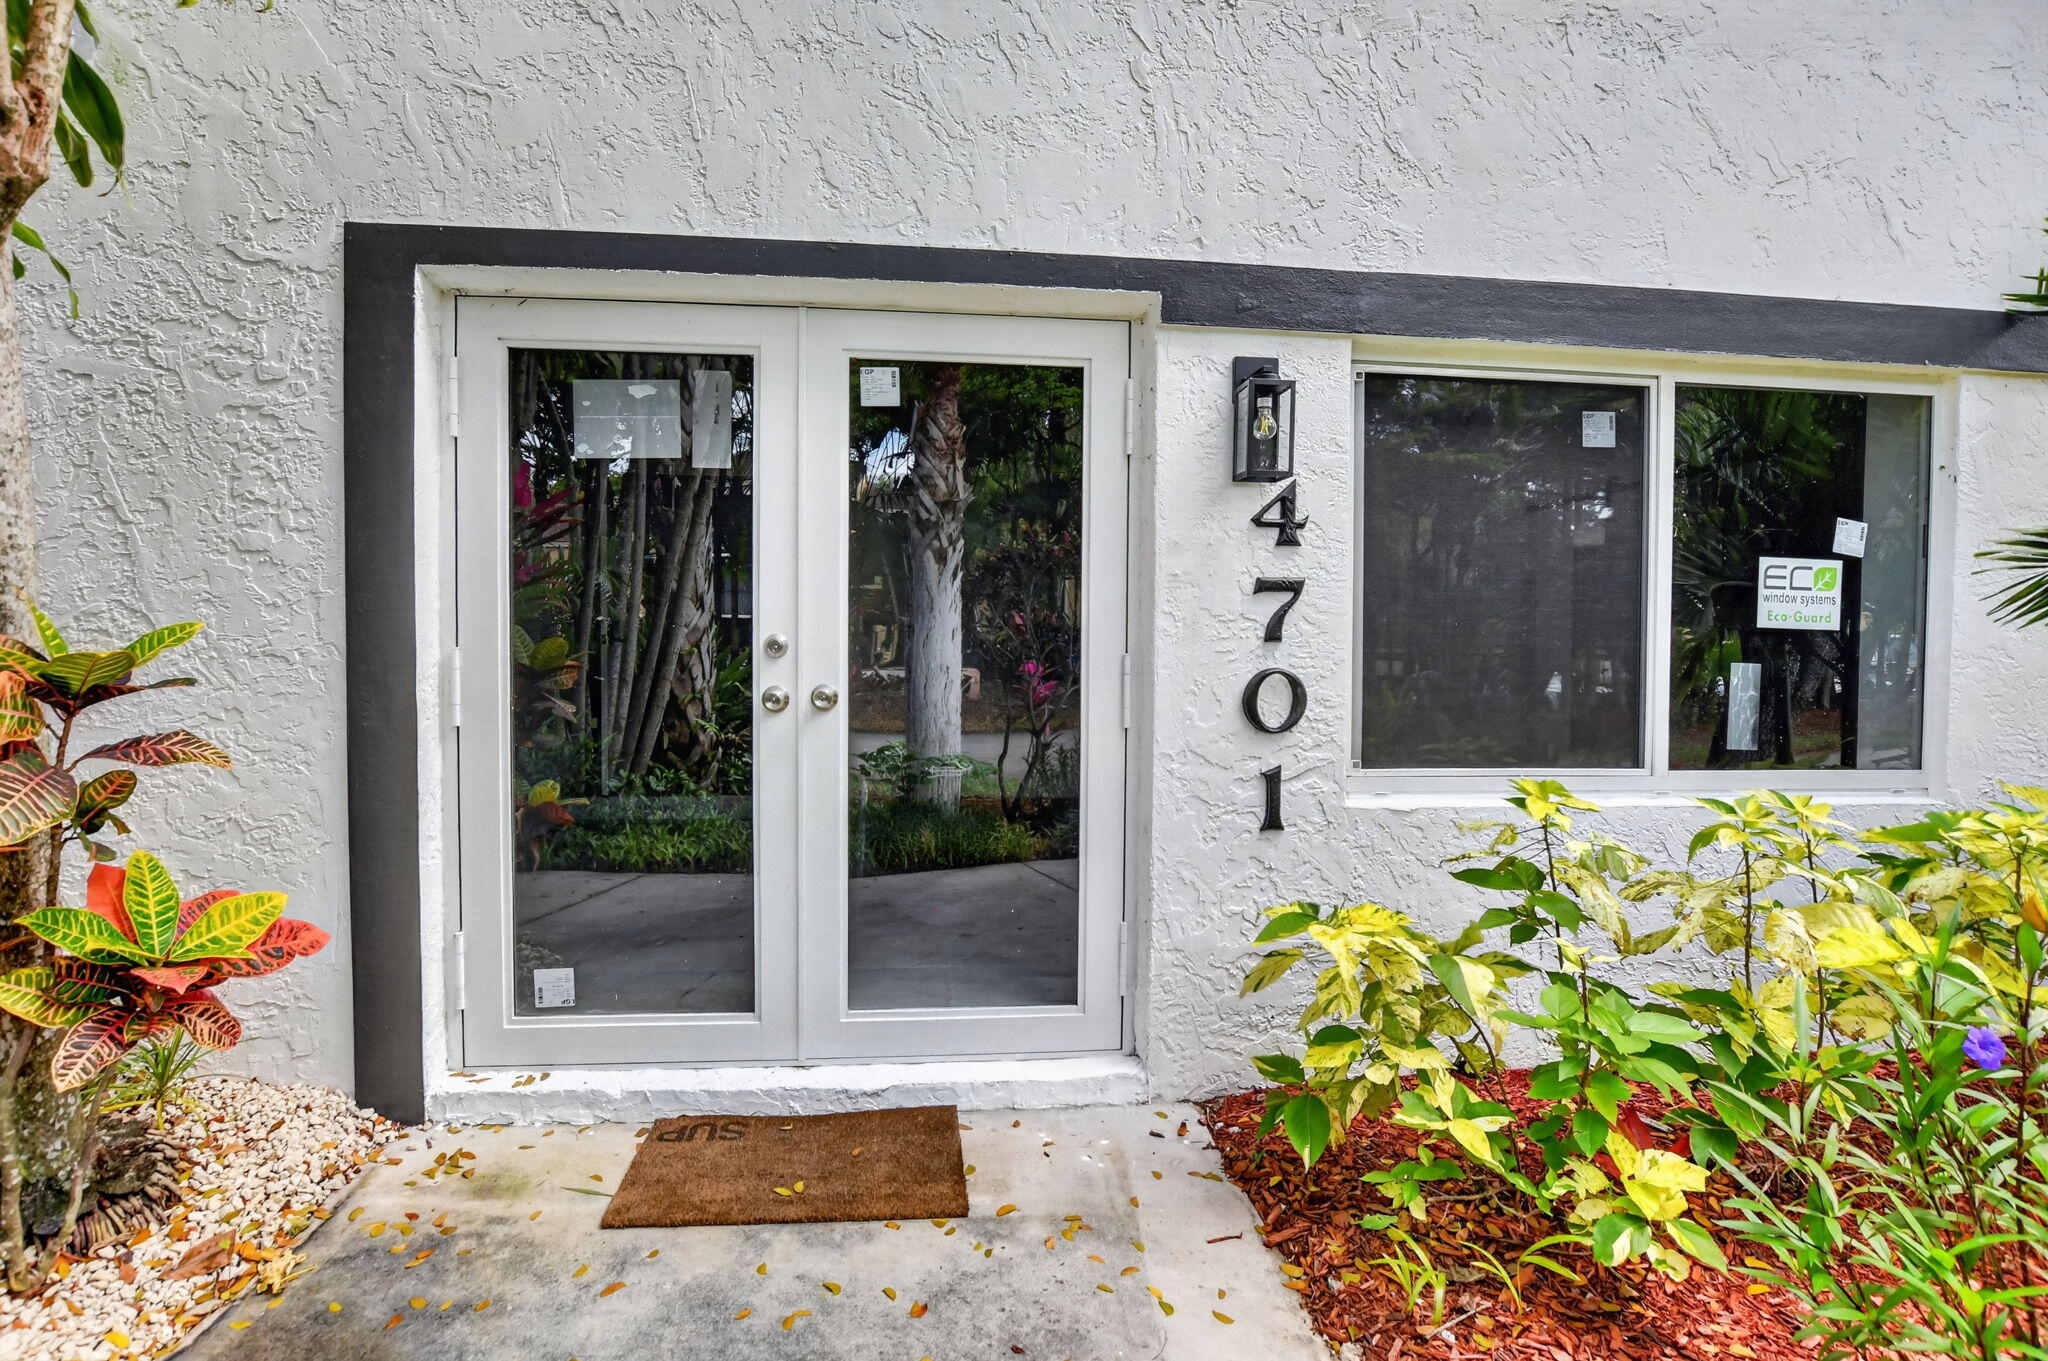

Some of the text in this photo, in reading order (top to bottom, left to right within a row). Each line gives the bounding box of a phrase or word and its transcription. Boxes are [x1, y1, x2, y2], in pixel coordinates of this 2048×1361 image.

[1763, 592, 1837, 607] window systems
[1767, 610, 1832, 623] Eco-Guard
[1242, 479, 1309, 831] 4701
[656, 1121, 750, 1142] SUP
